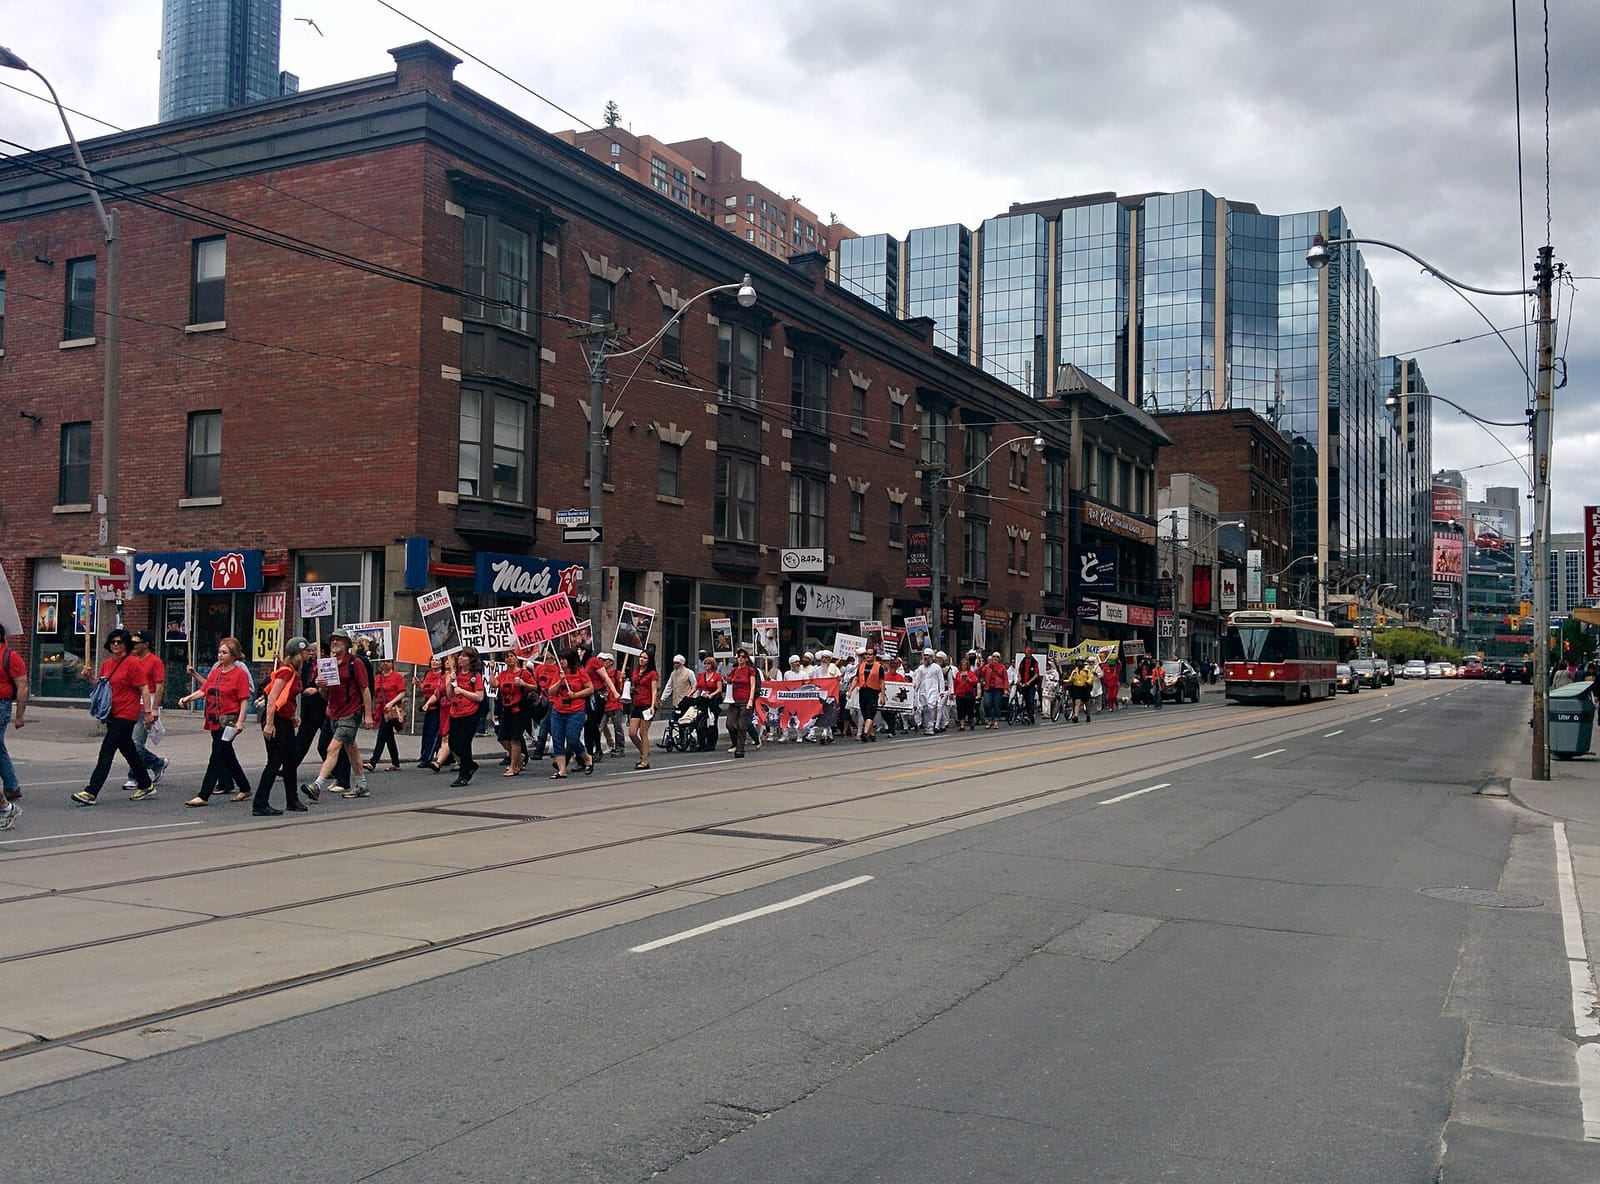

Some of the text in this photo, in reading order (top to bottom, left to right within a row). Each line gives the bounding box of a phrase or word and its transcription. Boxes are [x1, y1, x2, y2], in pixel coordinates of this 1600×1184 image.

[492, 560, 552, 596] Mac's
[257, 596, 282, 612] MILK
[421, 597, 448, 612] SLAUGHTER
[423, 591, 442, 603] END THE
[462, 611, 482, 623] THEY
[510, 597, 567, 626] MEET YOUR
[462, 622, 513, 635] THEY FEAR
[463, 635, 485, 647] THEY
[518, 628, 545, 647] MEAT
